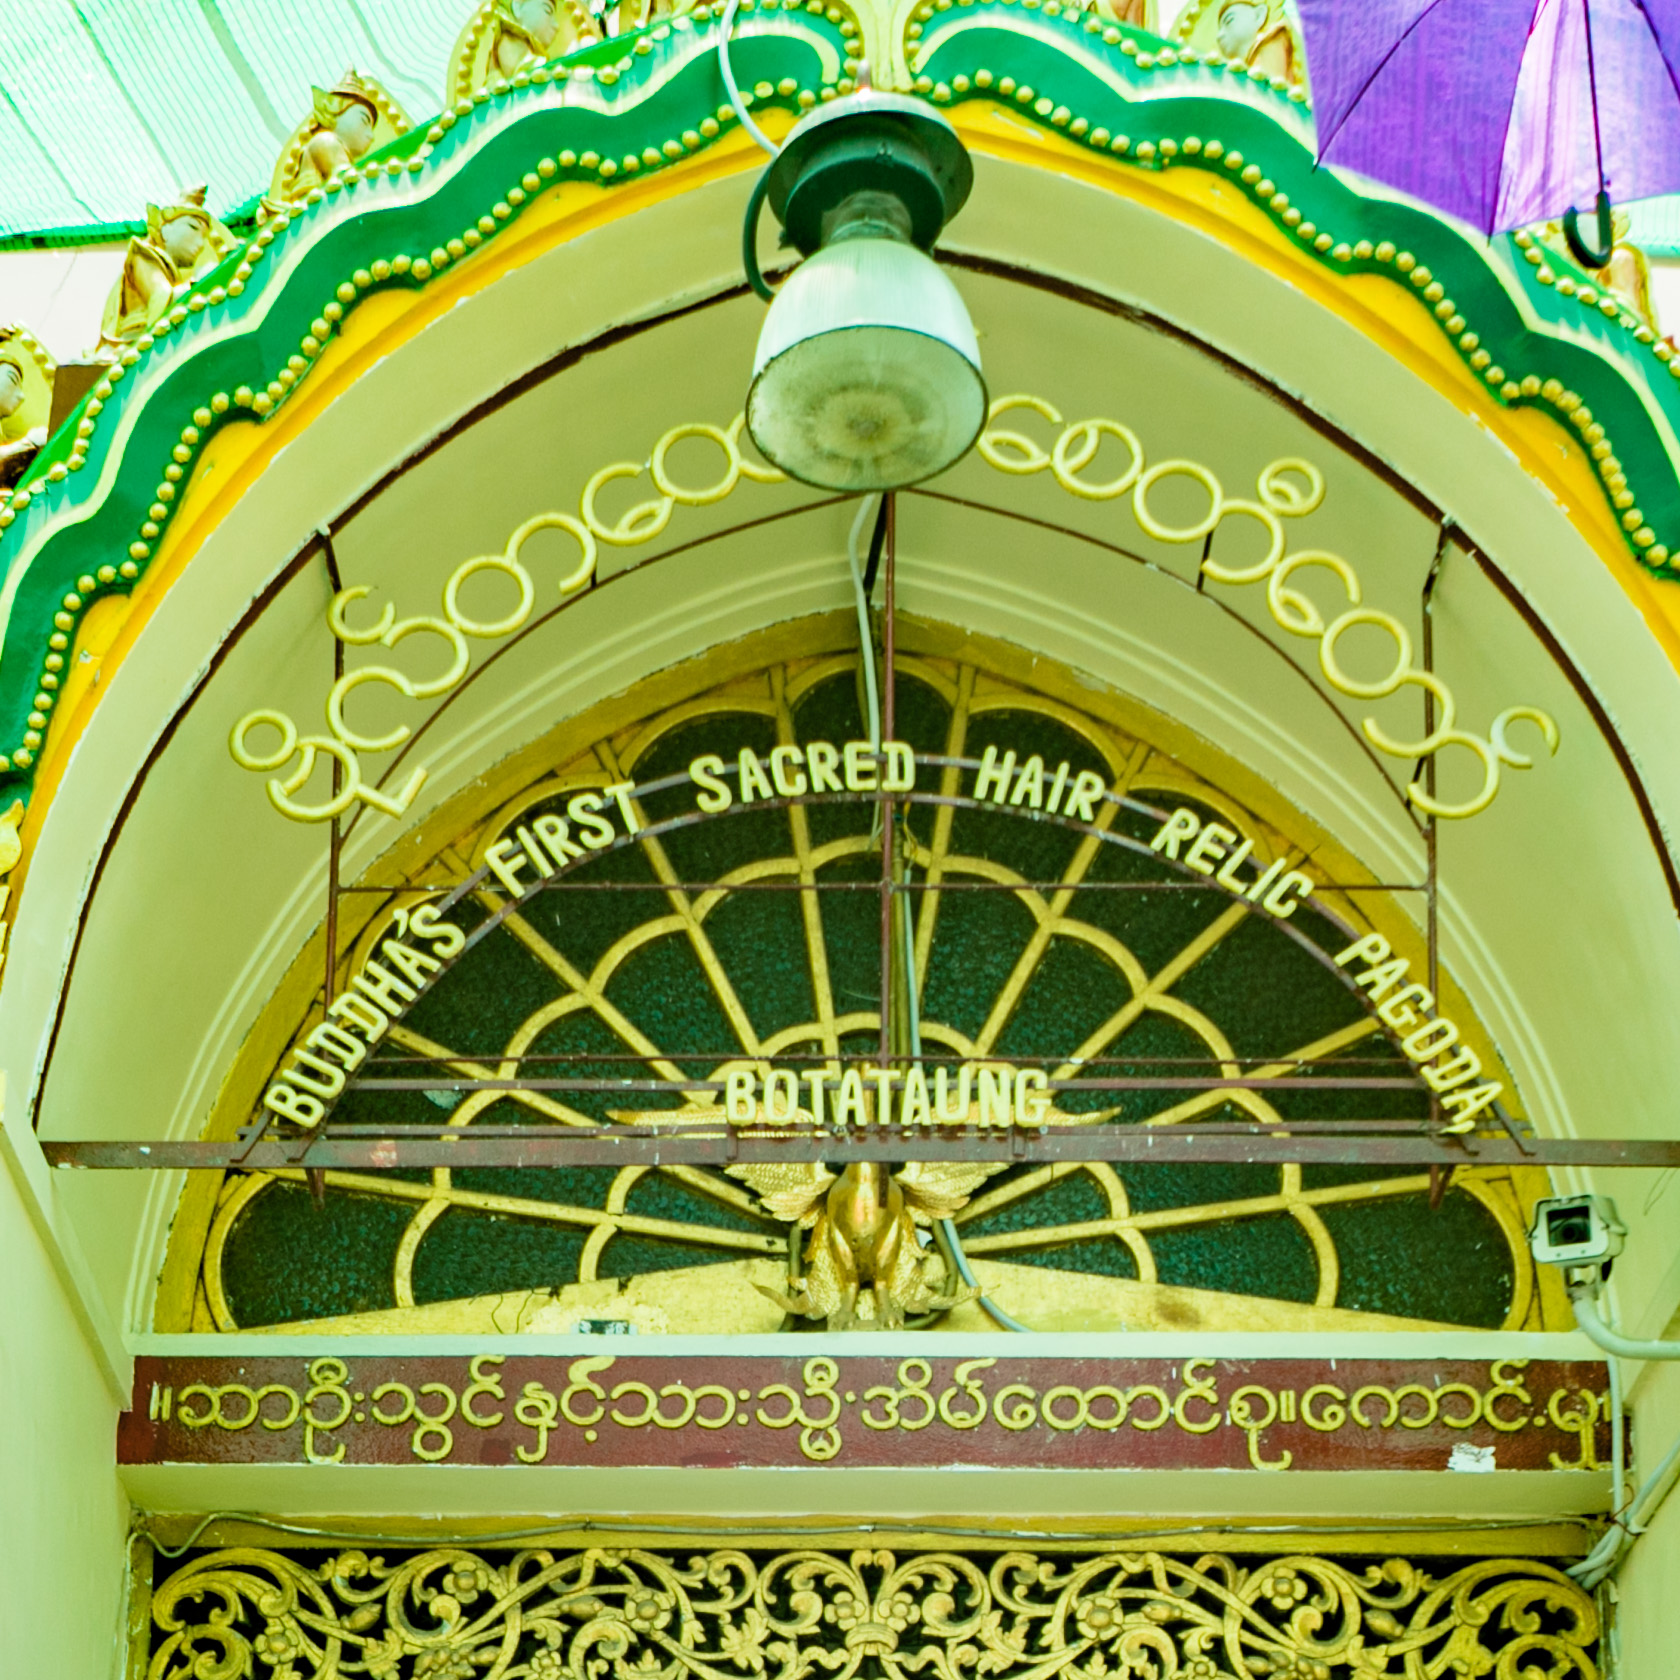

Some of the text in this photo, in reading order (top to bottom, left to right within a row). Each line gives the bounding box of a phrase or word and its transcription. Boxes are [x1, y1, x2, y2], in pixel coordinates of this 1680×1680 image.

[264, 903, 466, 1128] BUDDHA'S
[484, 780, 641, 898] FIRST
[688, 741, 916, 814] SACRED
[973, 744, 1107, 822] HAIR
[1150, 807, 1315, 919] RELIC
[725, 1064, 1053, 1128] BOTATAUNG
